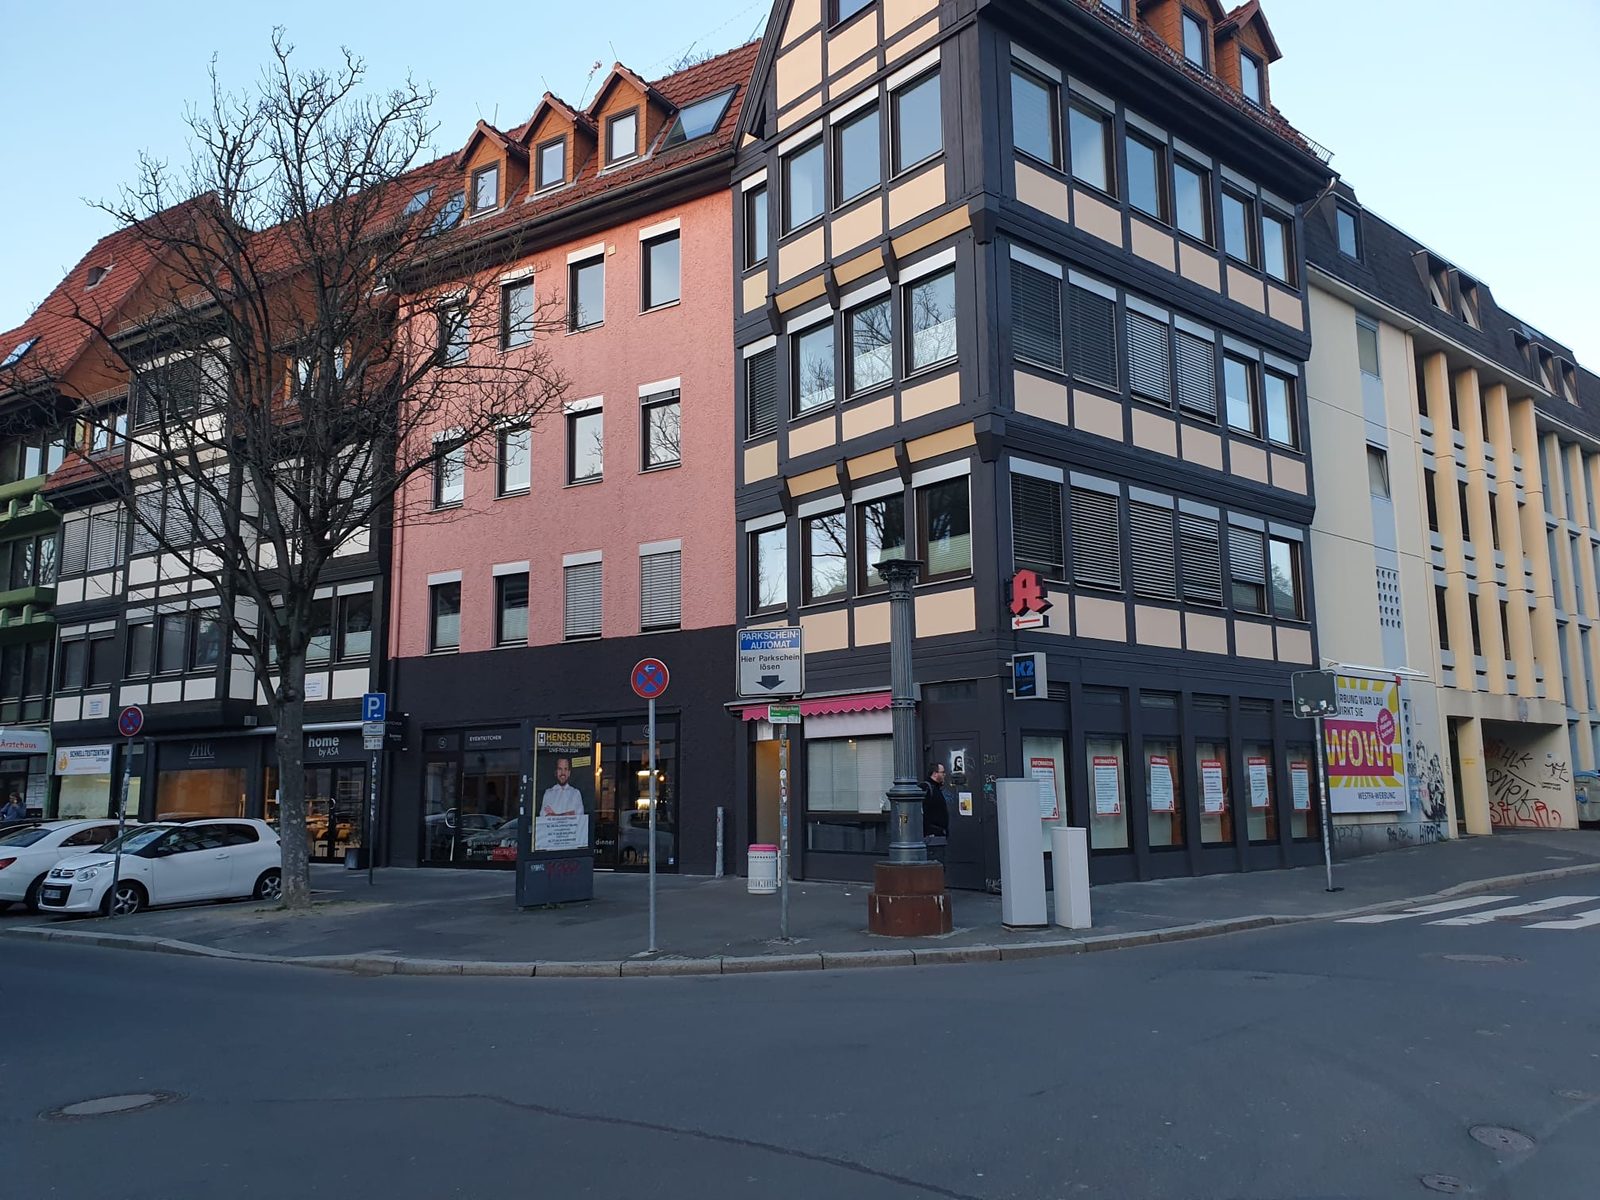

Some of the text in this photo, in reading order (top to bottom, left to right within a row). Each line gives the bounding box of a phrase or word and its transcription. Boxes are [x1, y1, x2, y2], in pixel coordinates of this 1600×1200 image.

[741, 631, 799, 640] PARKSCHEIN-
[751, 640, 791, 649] AUTOMAT
[759, 654, 800, 662] Parkschein
[1015, 661, 1034, 676] K2
[1339, 693, 1358, 704] RBUNG
[1359, 695, 1372, 705] WAR
[368, 697, 380, 718] P
[1355, 707, 1364, 716] SIE
[546, 732, 591, 742] HENSSLERS
[0, 738, 37, 749] Ärztehaus
[308, 737, 340, 748] home
[69, 748, 110, 758] SCHNELLTESTZENTRUM
[319, 747, 339, 757] by ASA
[1325, 729, 1392, 767] WOW!
